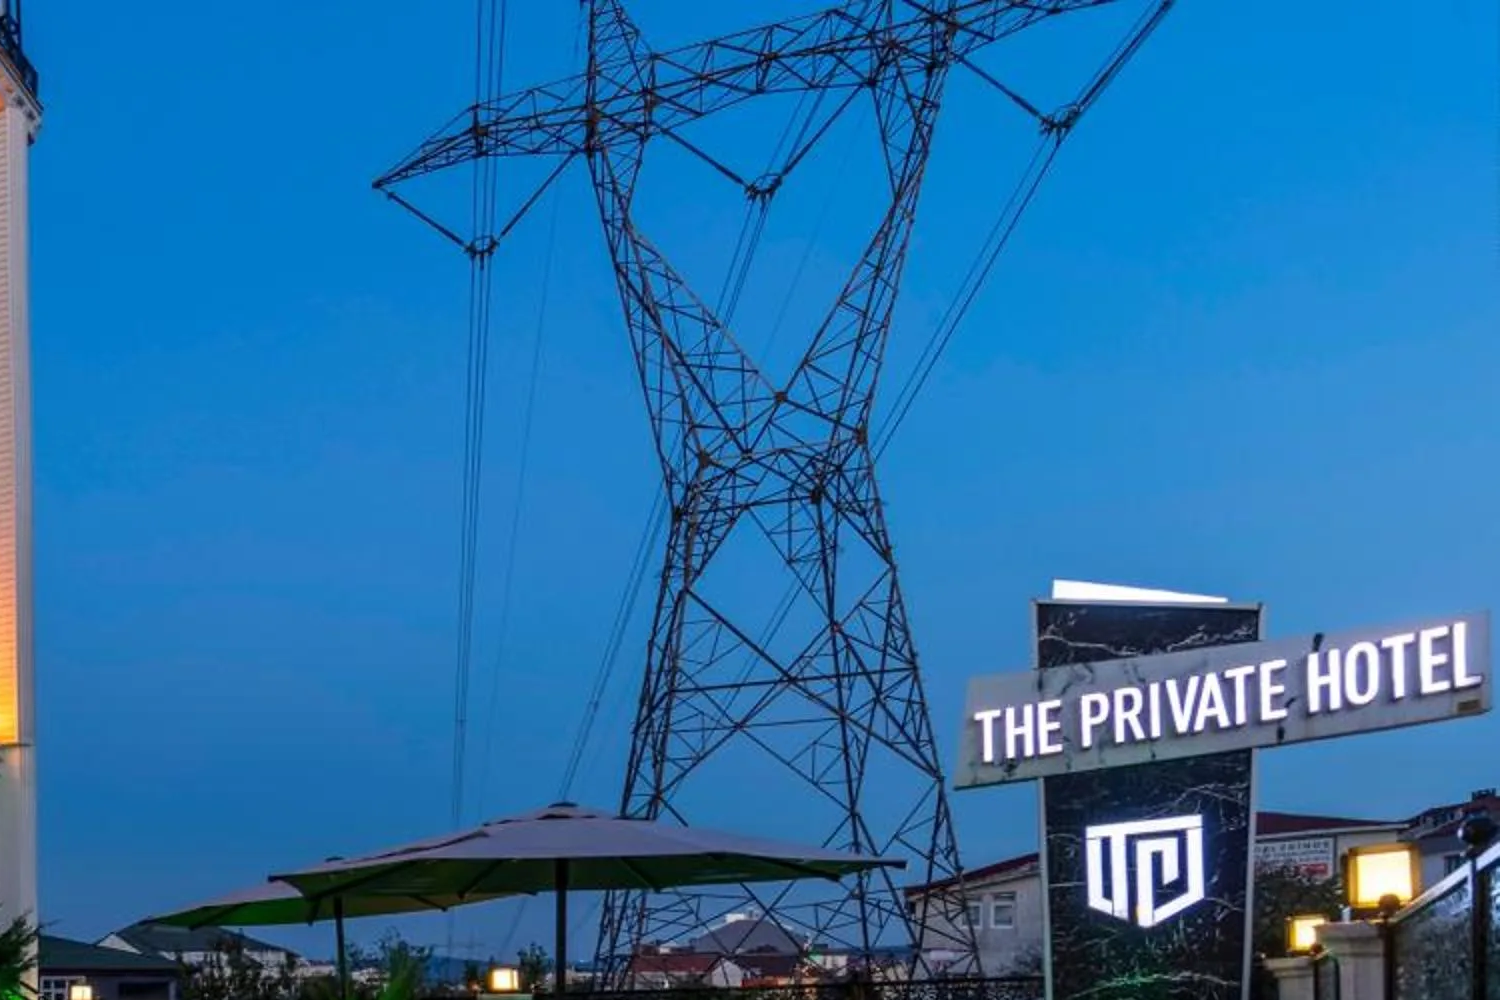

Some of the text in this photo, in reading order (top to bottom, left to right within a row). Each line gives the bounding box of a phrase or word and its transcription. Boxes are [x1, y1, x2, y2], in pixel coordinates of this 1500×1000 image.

[974, 620, 1483, 764] THE PRIVATE HOTEL
